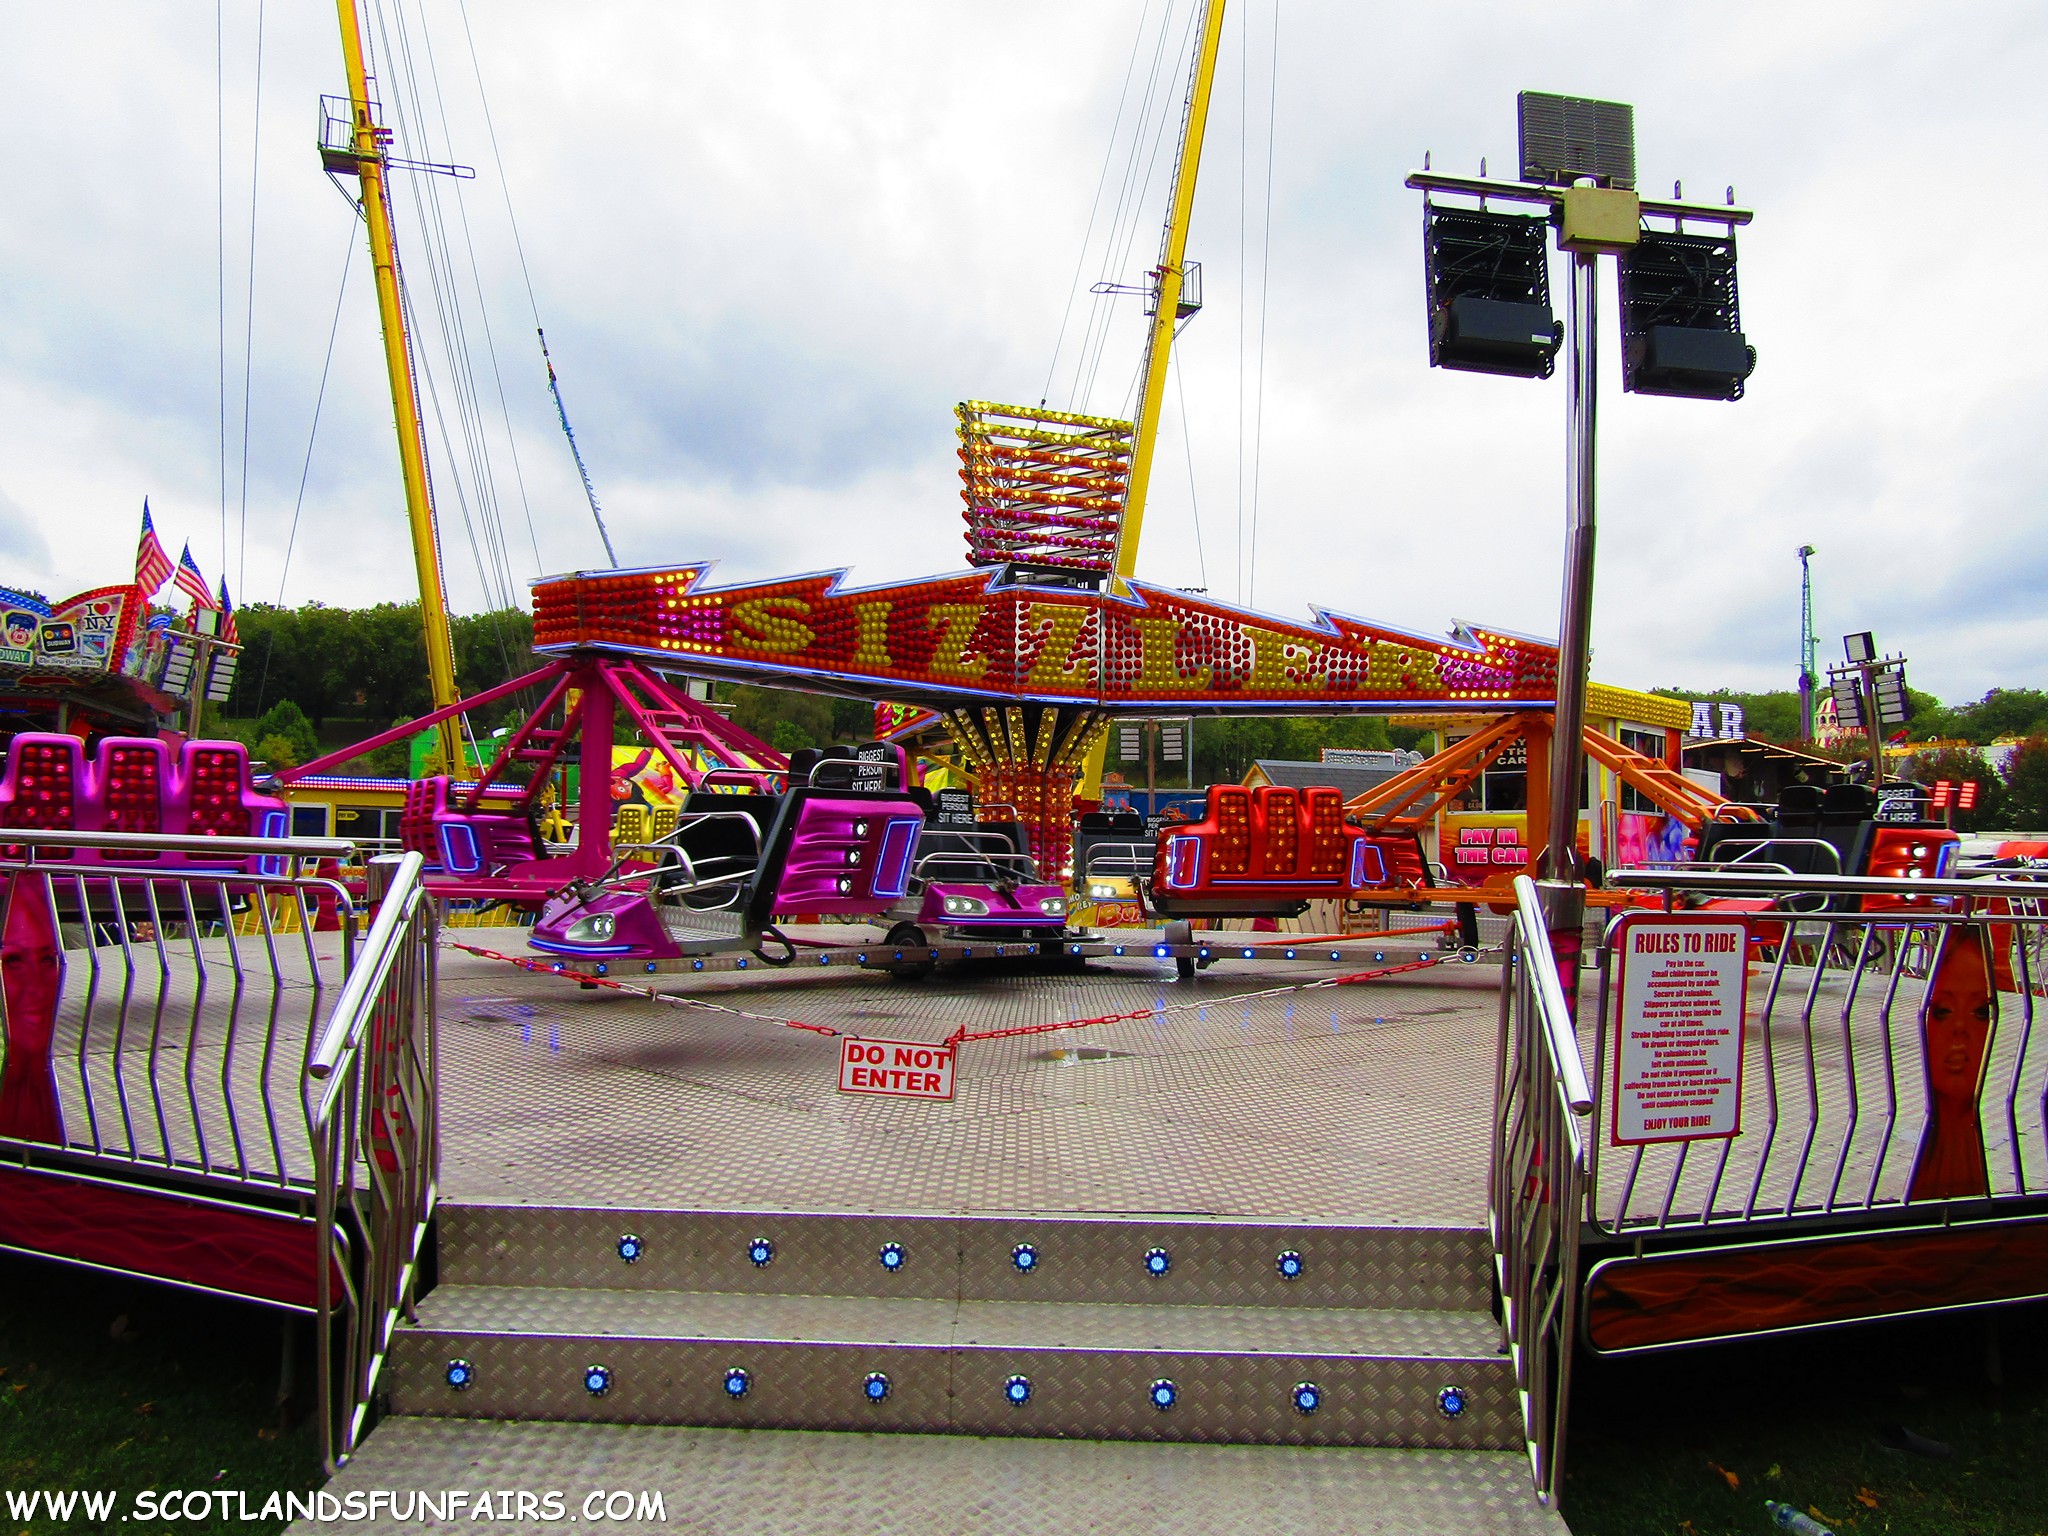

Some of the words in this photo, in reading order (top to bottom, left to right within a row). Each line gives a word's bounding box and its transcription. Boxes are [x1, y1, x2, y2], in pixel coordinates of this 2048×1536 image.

[86, 604, 94, 616] I
[84, 616, 116, 630] NY
[730, 596, 1439, 690] SIZZLER
[858, 748, 884, 761] BIGGEST
[1497, 756, 1527, 765] CAR
[852, 782, 862, 791] SIT
[940, 794, 970, 802] BIGGEST
[1878, 788, 1914, 799] BIGGEST
[942, 802, 969, 811] PERSON
[938, 812, 950, 823] SIT
[952, 814, 974, 824] HERE
[1460, 828, 1494, 844] PAY
[1496, 828, 1517, 844] IN
[1455, 848, 1488, 864] THE
[1492, 848, 1528, 864] CAR
[1635, 933, 1680, 954] RULES
[1683, 932, 1701, 953] TO
[1704, 932, 1736, 952] RIDE
[1666, 960, 1676, 968] Pay
[1647, 980, 1687, 988] accompanied
[1650, 1040, 1667, 1048] drunk
[848, 1044, 885, 1064] DO
[894, 1048, 950, 1070] NOT
[1679, 1069, 1705, 1077] pregnant
[852, 1068, 942, 1092] ENTER
[1624, 1082, 1651, 1090] suffering
[1657, 1100, 1688, 1108] completely
[1644, 1118, 1667, 1130] ENJOY
[1669, 1116, 1689, 1128] YOUR
[1690, 1115, 1711, 1127] RIDE!
